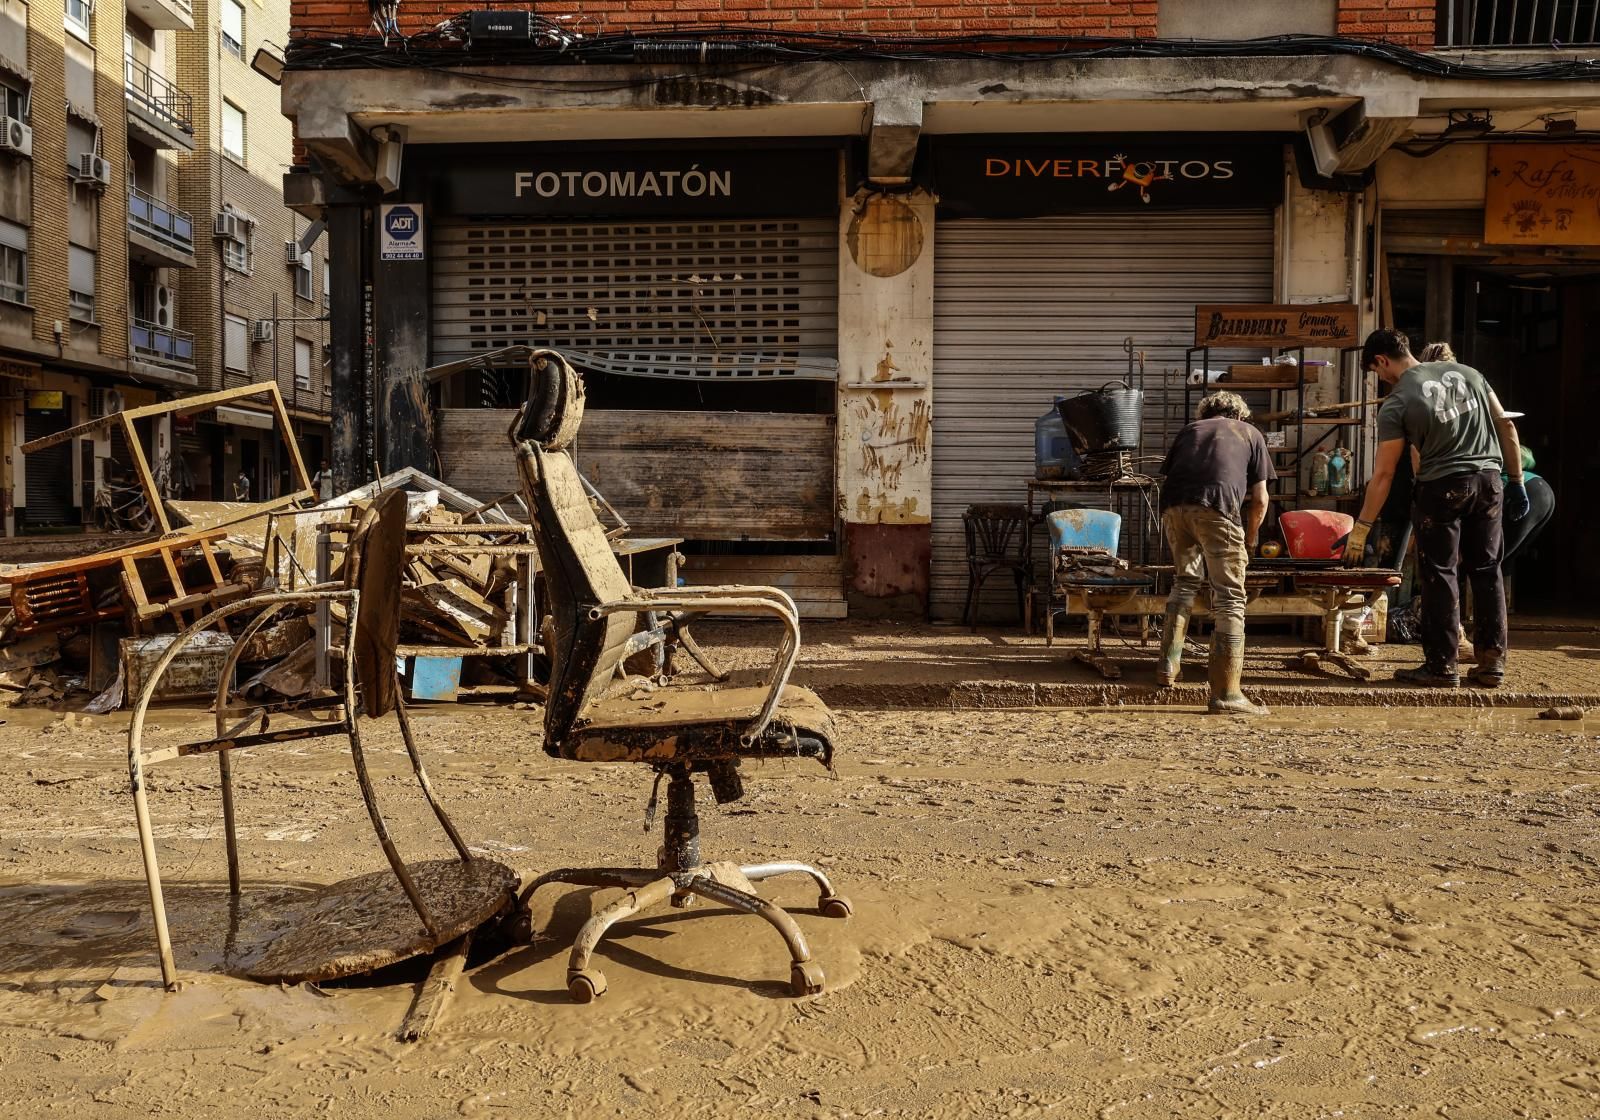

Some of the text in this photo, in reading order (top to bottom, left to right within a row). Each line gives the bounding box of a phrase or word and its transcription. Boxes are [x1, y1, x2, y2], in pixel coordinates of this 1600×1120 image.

[515, 163, 731, 197] FOTOMATÓN
[1505, 160, 1577, 189] Rafa
[391, 217, 413, 229] ADT
[1300, 312, 1339, 328] Genuine
[1328, 325, 1349, 338] Style
[1422, 370, 1479, 424] 22
